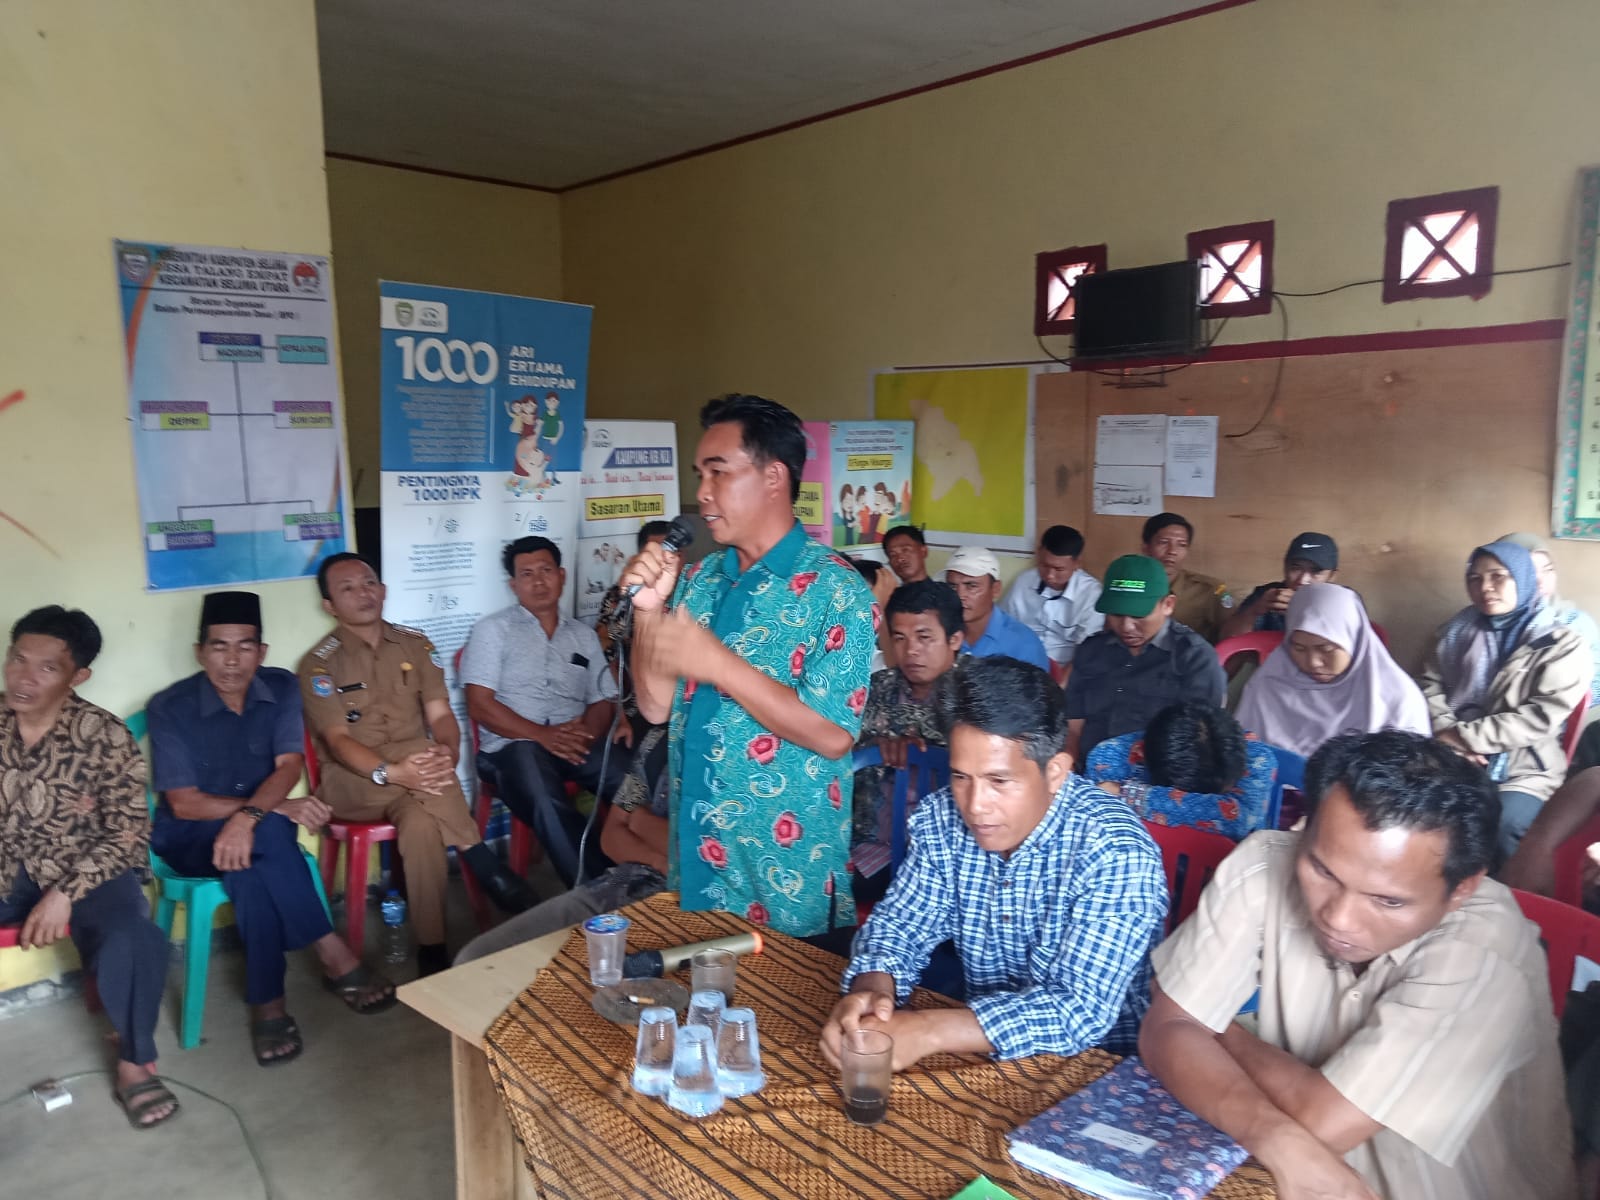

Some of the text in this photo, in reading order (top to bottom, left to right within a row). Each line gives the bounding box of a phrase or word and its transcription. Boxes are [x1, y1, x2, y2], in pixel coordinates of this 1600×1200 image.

[395, 336, 499, 385] 1000
[398, 475, 481, 488] PENTINGNYA
[413, 487, 481, 501] 1000 HPK
[591, 499, 661, 516] Sasaran Utama
